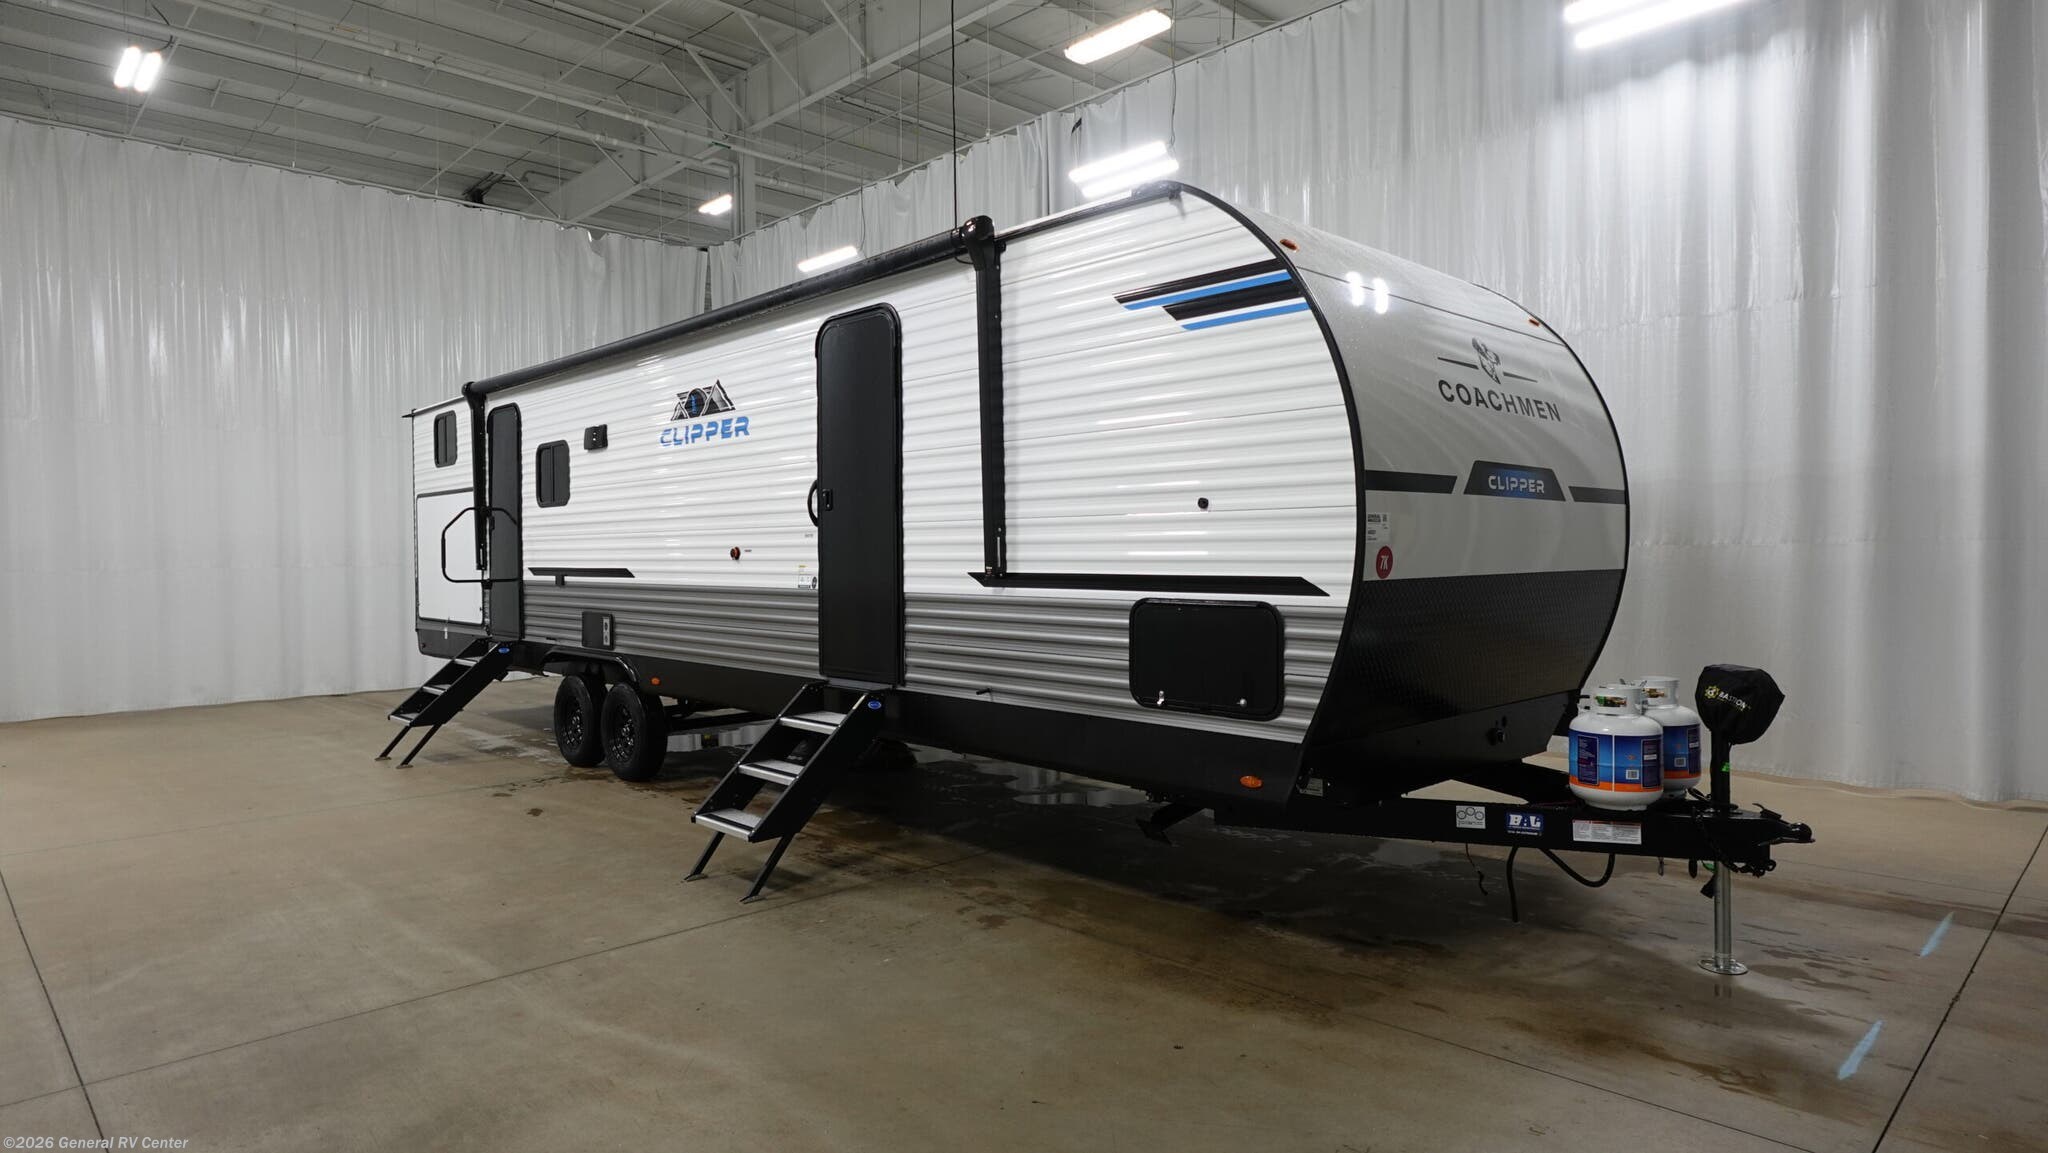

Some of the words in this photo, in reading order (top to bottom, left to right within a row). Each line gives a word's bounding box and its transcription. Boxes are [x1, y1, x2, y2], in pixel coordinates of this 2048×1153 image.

[1438, 379, 1561, 422] COACHMEN
[660, 416, 750, 446] CLIPPER
[1488, 475, 1545, 494] CLIPPER
[1718, 691, 1747, 709] BASTION
[1509, 814, 1542, 828] BAL
